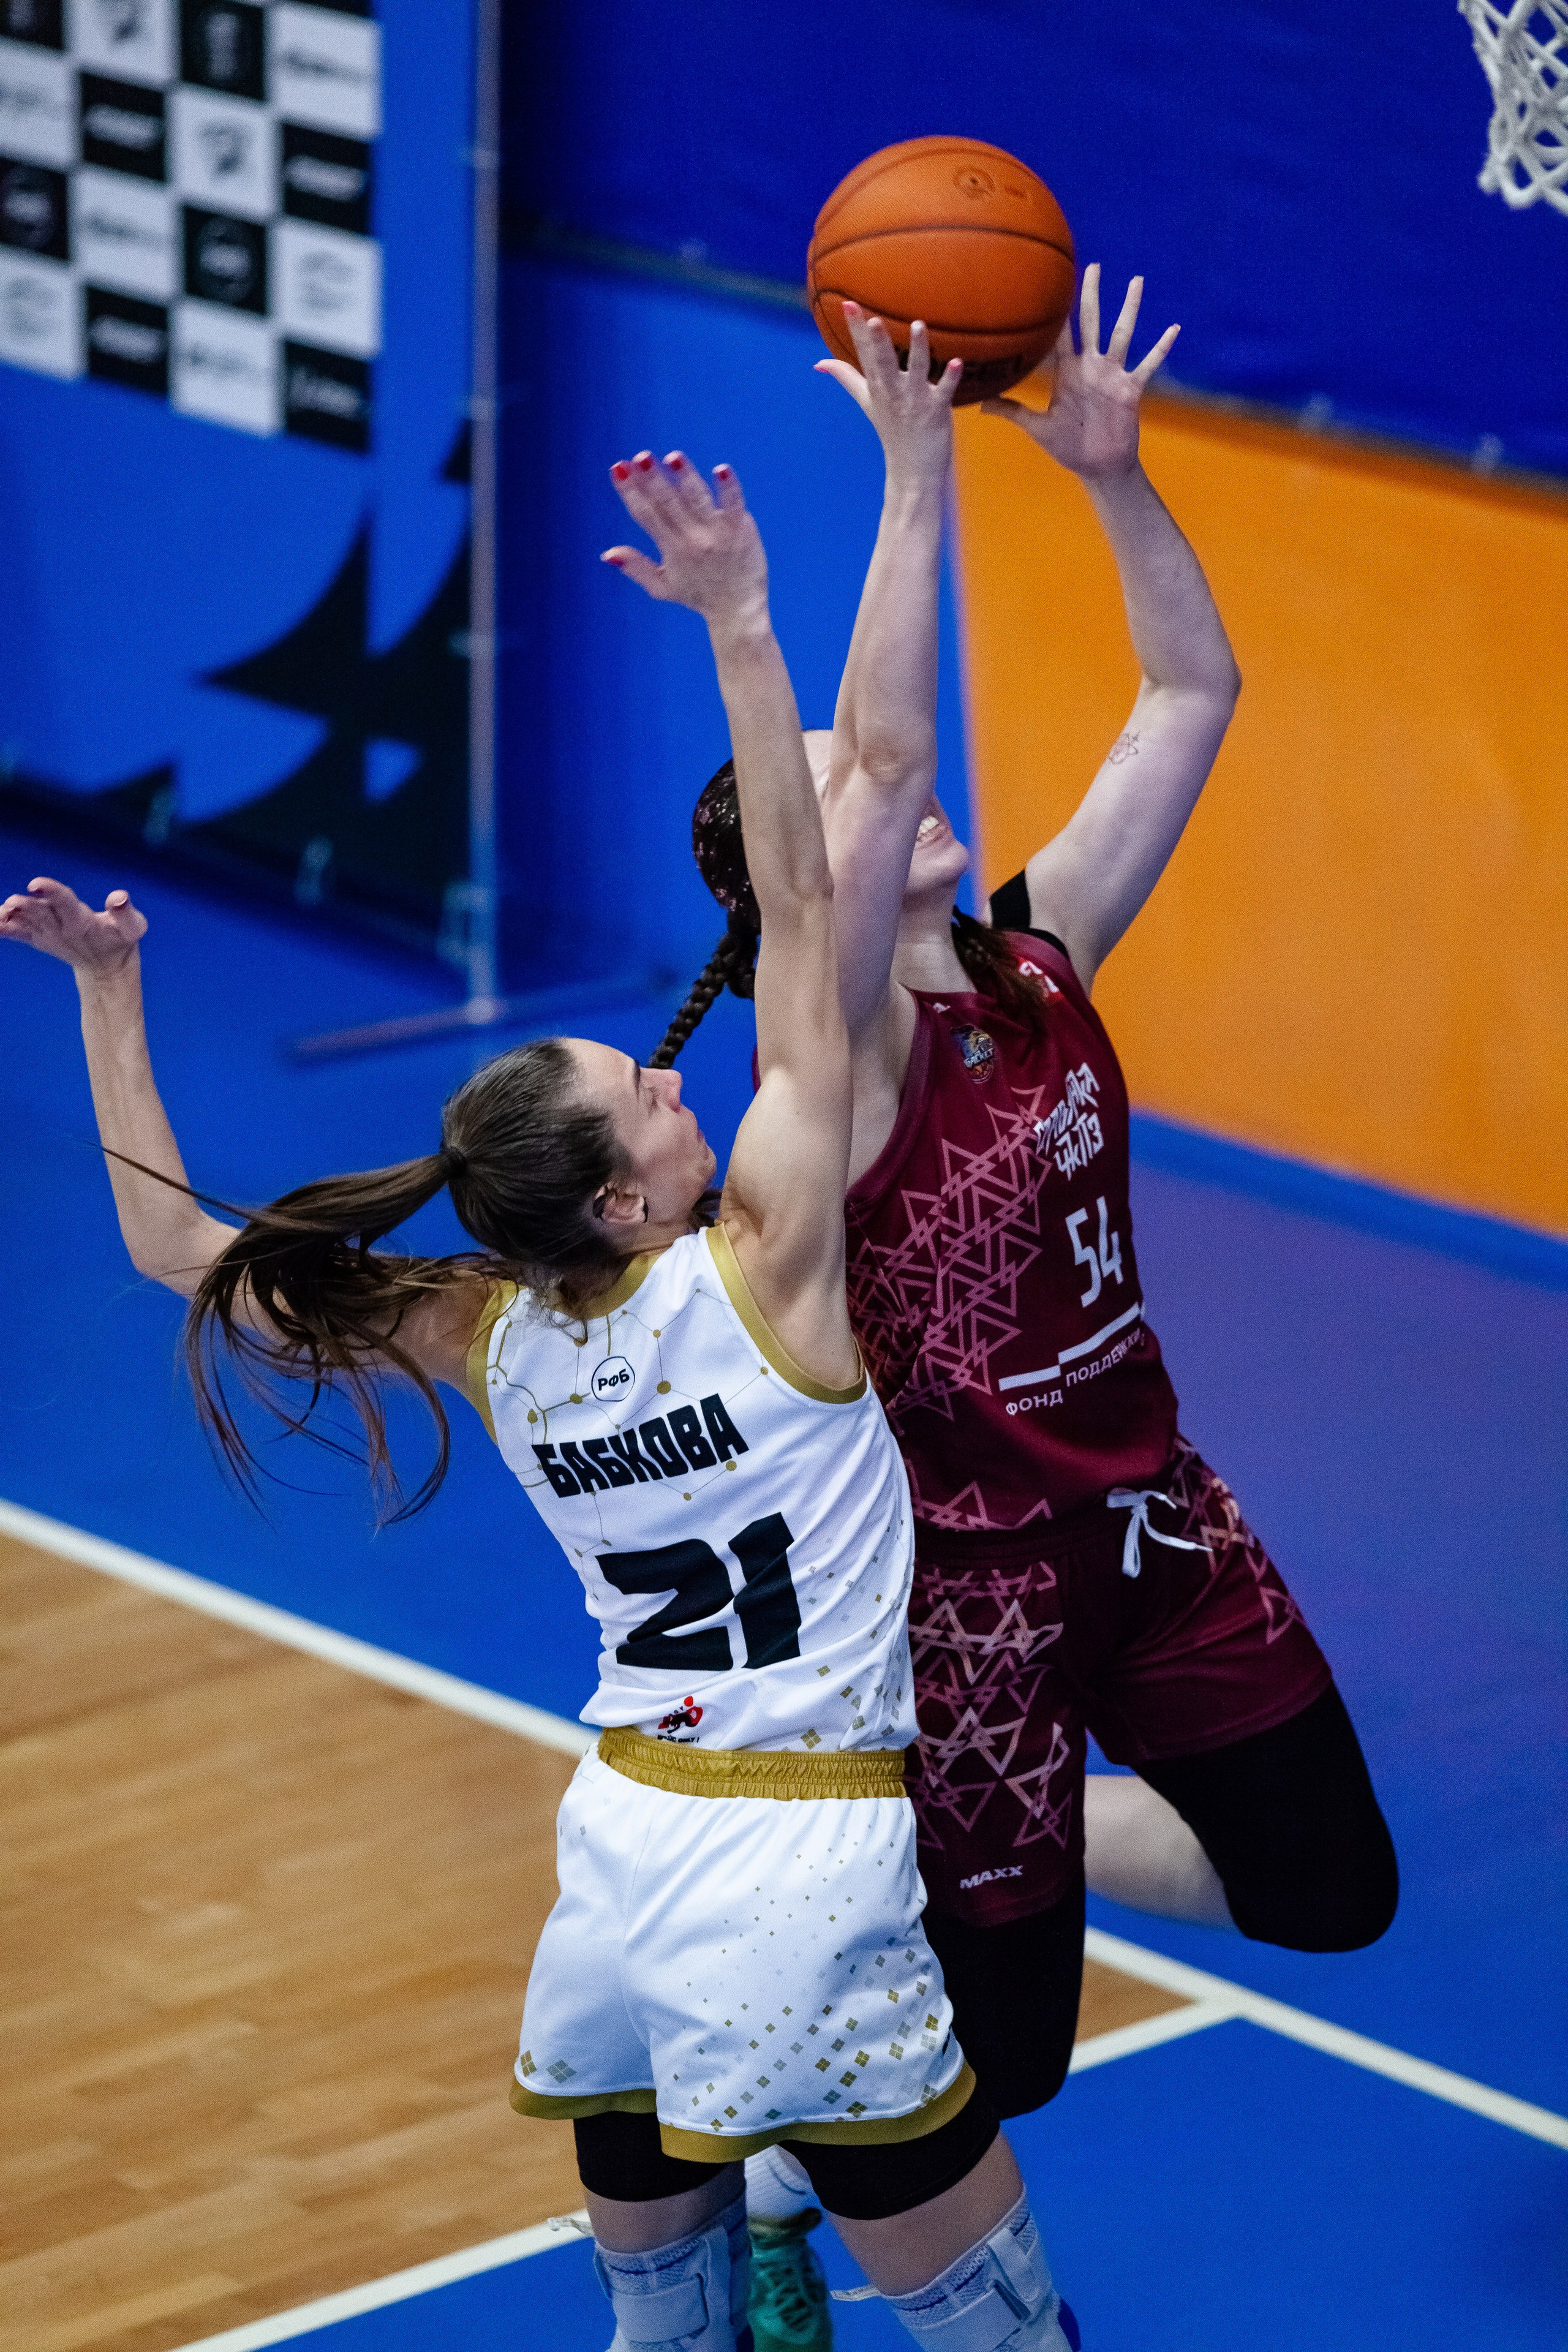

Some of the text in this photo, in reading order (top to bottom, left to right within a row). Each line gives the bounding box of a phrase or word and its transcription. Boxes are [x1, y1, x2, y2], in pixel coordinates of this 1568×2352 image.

[1065, 1196, 1125, 1308] 54
[597, 1368, 630, 1392] РФБ
[1005, 1389, 1064, 1416] ФОНД
[531, 1393, 750, 1499] БАБКОВА
[594, 1512, 803, 1672] 21
[959, 1865, 1023, 1890] MAXX
